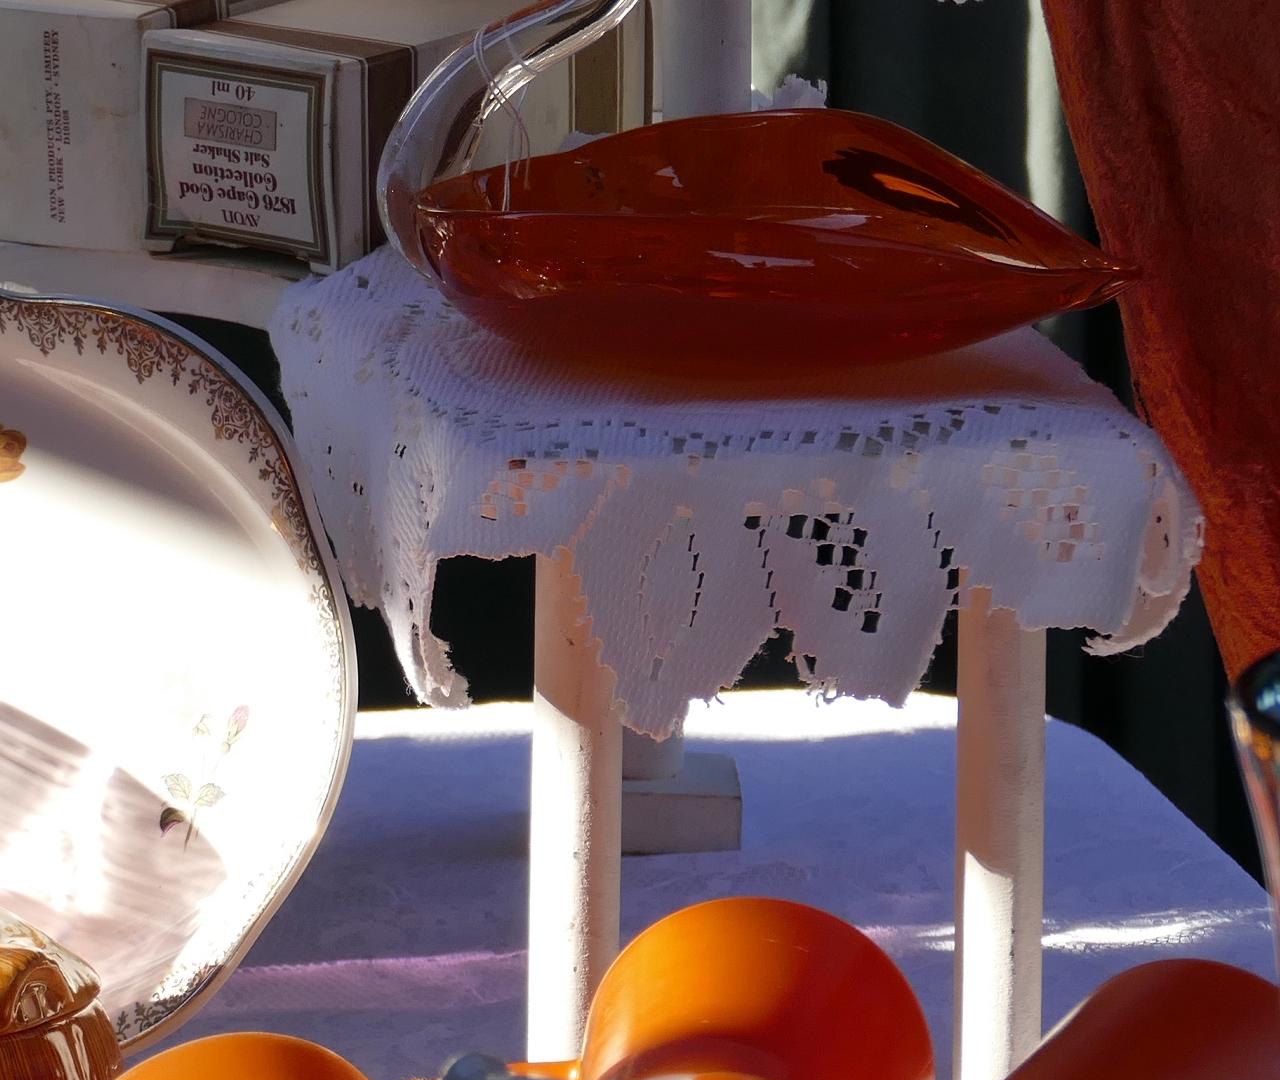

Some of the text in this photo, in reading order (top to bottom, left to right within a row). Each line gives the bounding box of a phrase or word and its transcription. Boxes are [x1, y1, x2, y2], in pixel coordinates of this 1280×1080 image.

[44, 31, 52, 82] LIMITED
[212, 80, 255, 102] 40 ml
[52, 30, 66, 224] NEW YORK LONDON SYDNEY
[200, 106, 262, 128] COLOGNE
[197, 122, 262, 145] CHARISMA
[47, 120, 56, 182] PRODUCTS
[193, 144, 270, 168] Salt Shaker
[193, 163, 277, 192] Collection
[50, 190, 58, 220] AVON
[179, 182, 297, 215] 1876 Cape Cod
